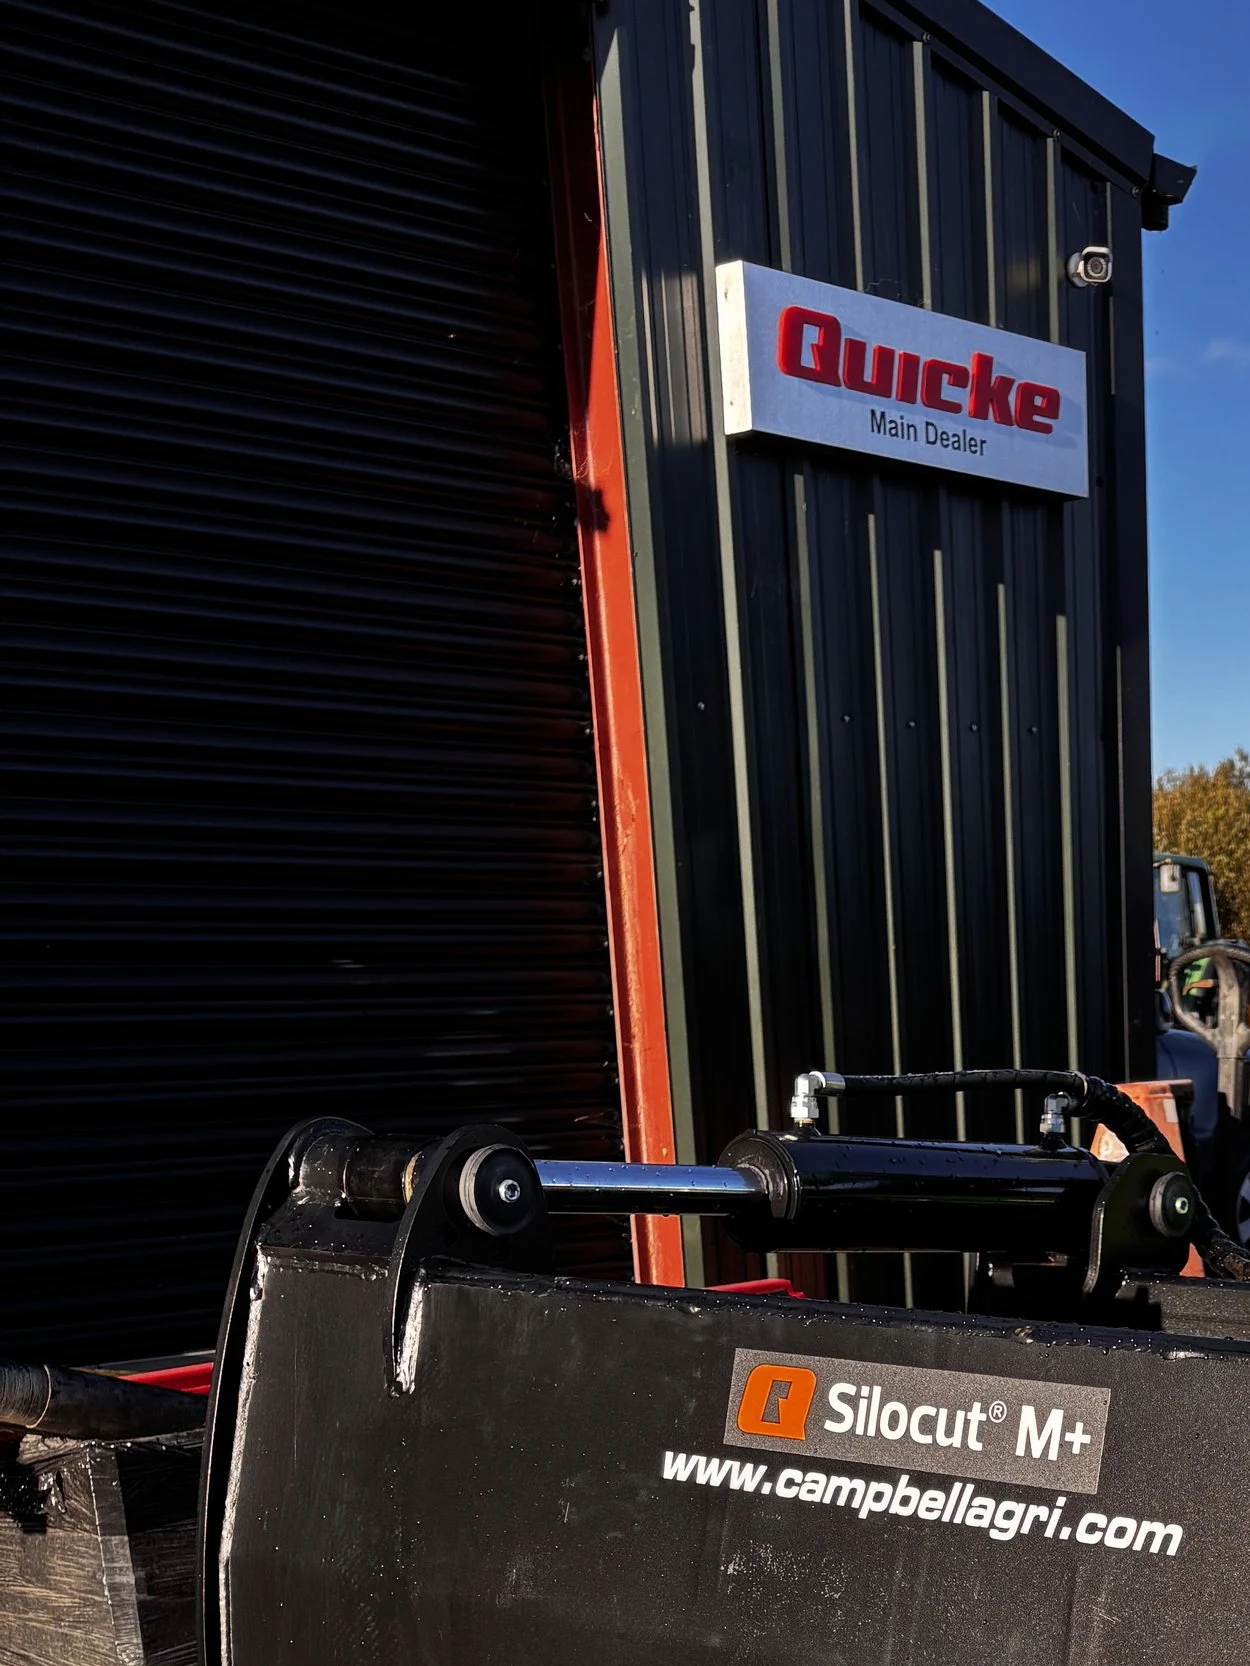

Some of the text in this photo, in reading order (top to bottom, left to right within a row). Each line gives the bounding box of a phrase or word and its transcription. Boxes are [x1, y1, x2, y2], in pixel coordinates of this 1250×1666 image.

[776, 305, 1061, 435] Quicke
[870, 409, 987, 456] Main Dealer
[1015, 1405, 1092, 1461] M+
[661, 1450, 1184, 1557] www.campbellagri.com
